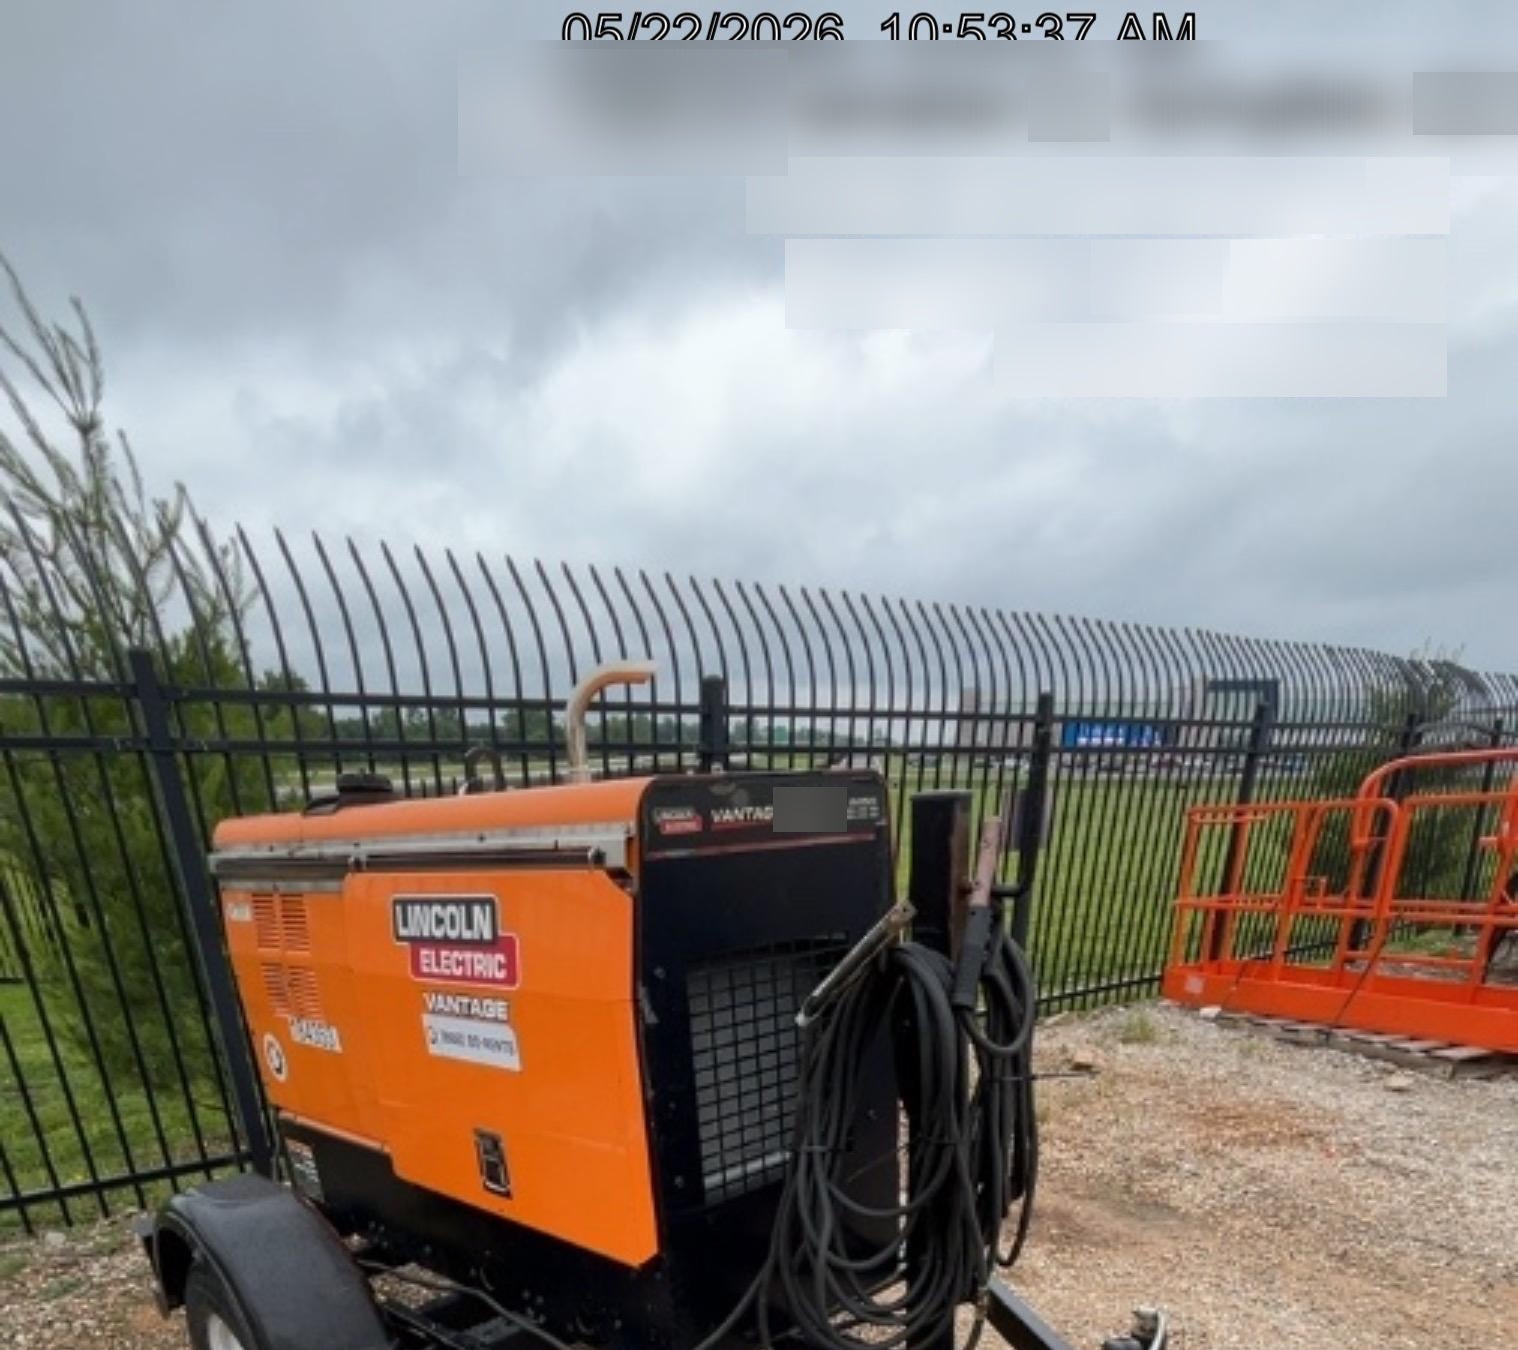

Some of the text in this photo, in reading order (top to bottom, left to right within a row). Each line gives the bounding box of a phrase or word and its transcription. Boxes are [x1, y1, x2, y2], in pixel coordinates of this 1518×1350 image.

[395, 903, 493, 941] LINCOLN
[418, 947, 507, 980] ELECTRIC
[422, 991, 509, 1021] VANTAGE
